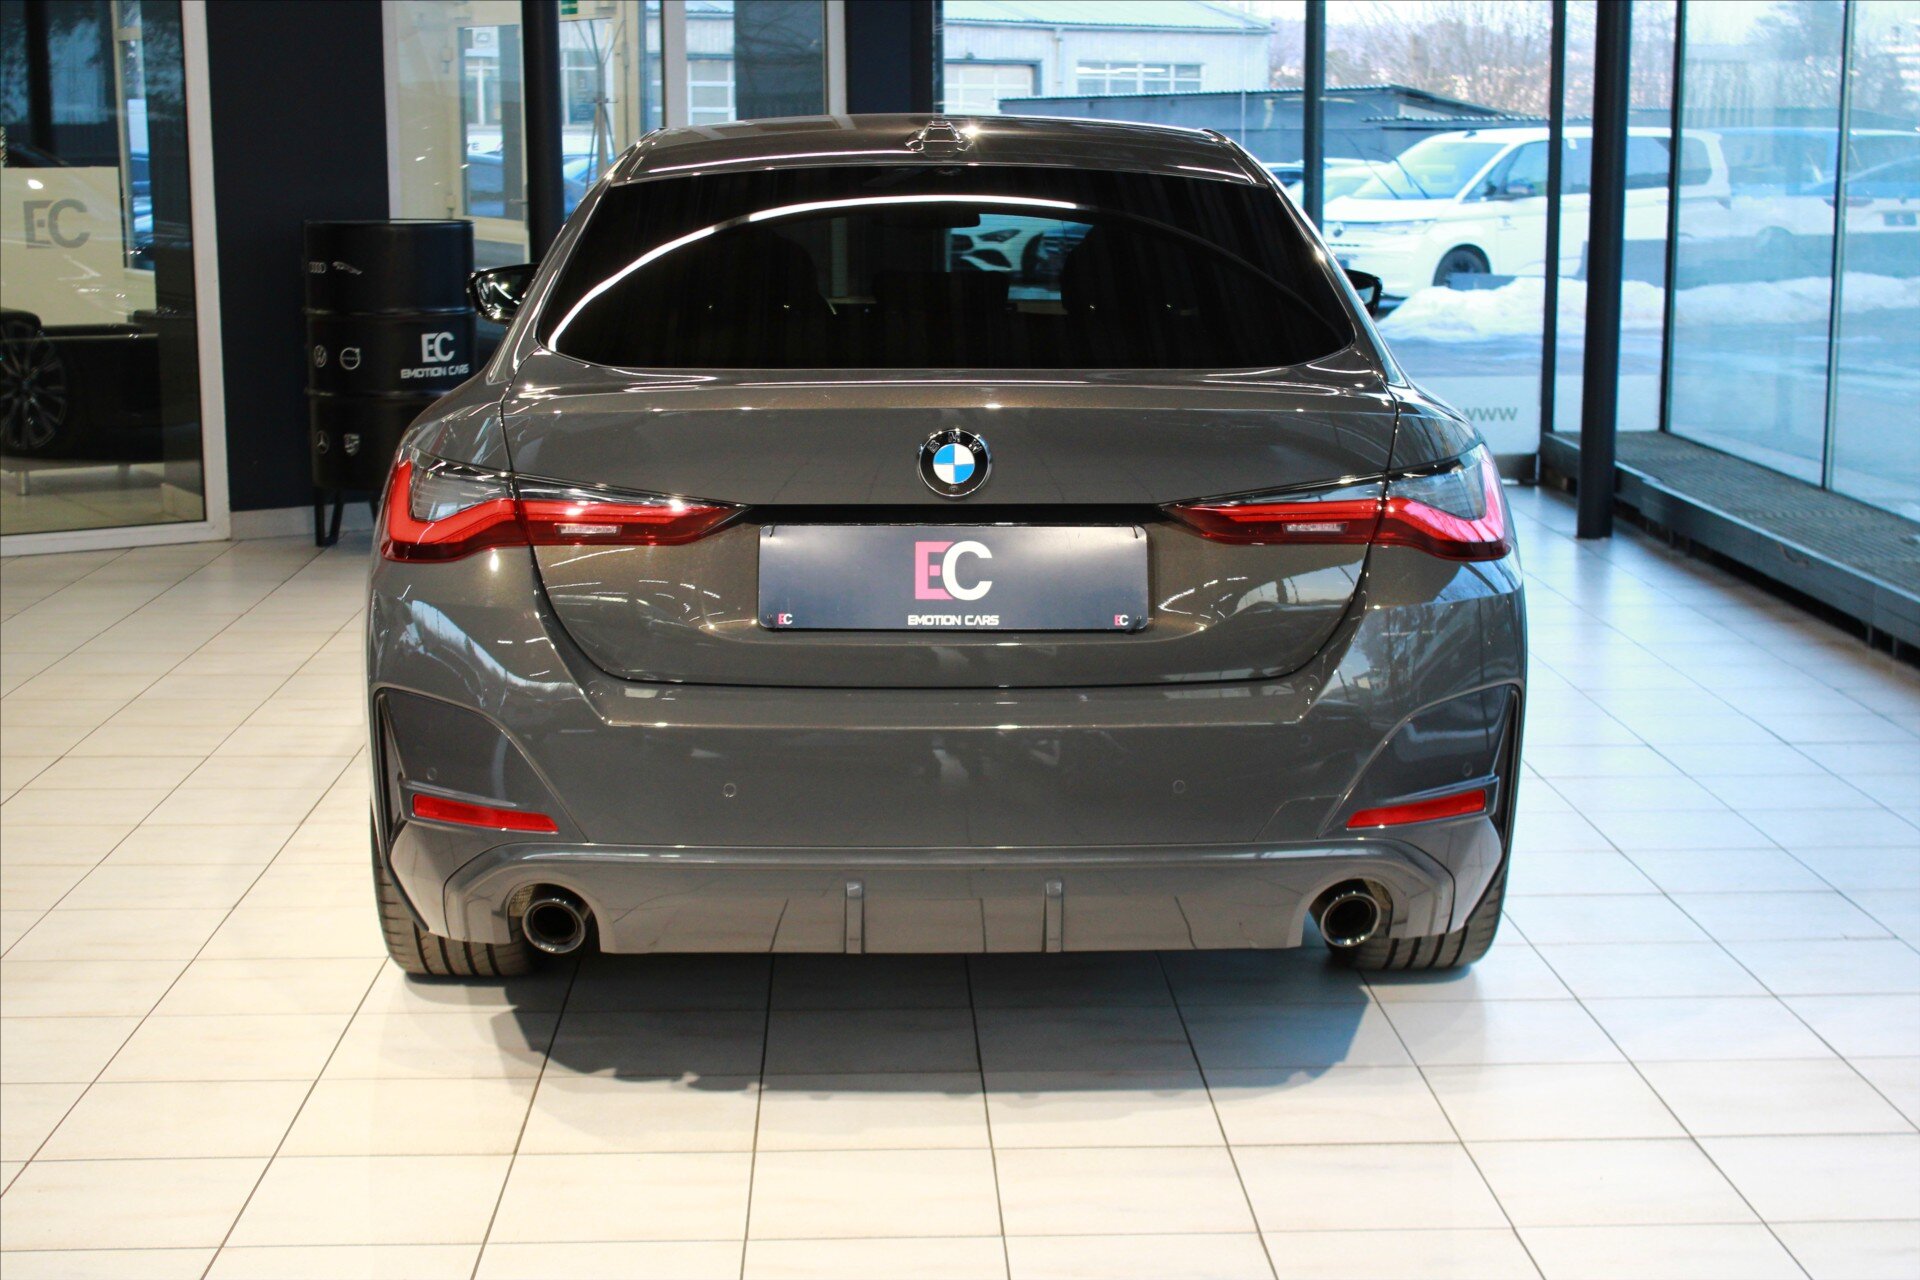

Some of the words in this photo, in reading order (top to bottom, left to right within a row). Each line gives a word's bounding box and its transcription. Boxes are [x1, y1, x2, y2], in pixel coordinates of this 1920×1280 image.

[23, 198, 90, 249] EC
[421, 331, 455, 363] EC
[401, 367, 447, 379] EMOTION
[448, 363, 470, 376] CARS
[927, 431, 983, 454] BMW
[915, 540, 993, 601] EC
[778, 613, 793, 625] EC
[907, 614, 962, 626] EMOTION
[964, 614, 1000, 626] CARS
[1114, 614, 1129, 626] EC
